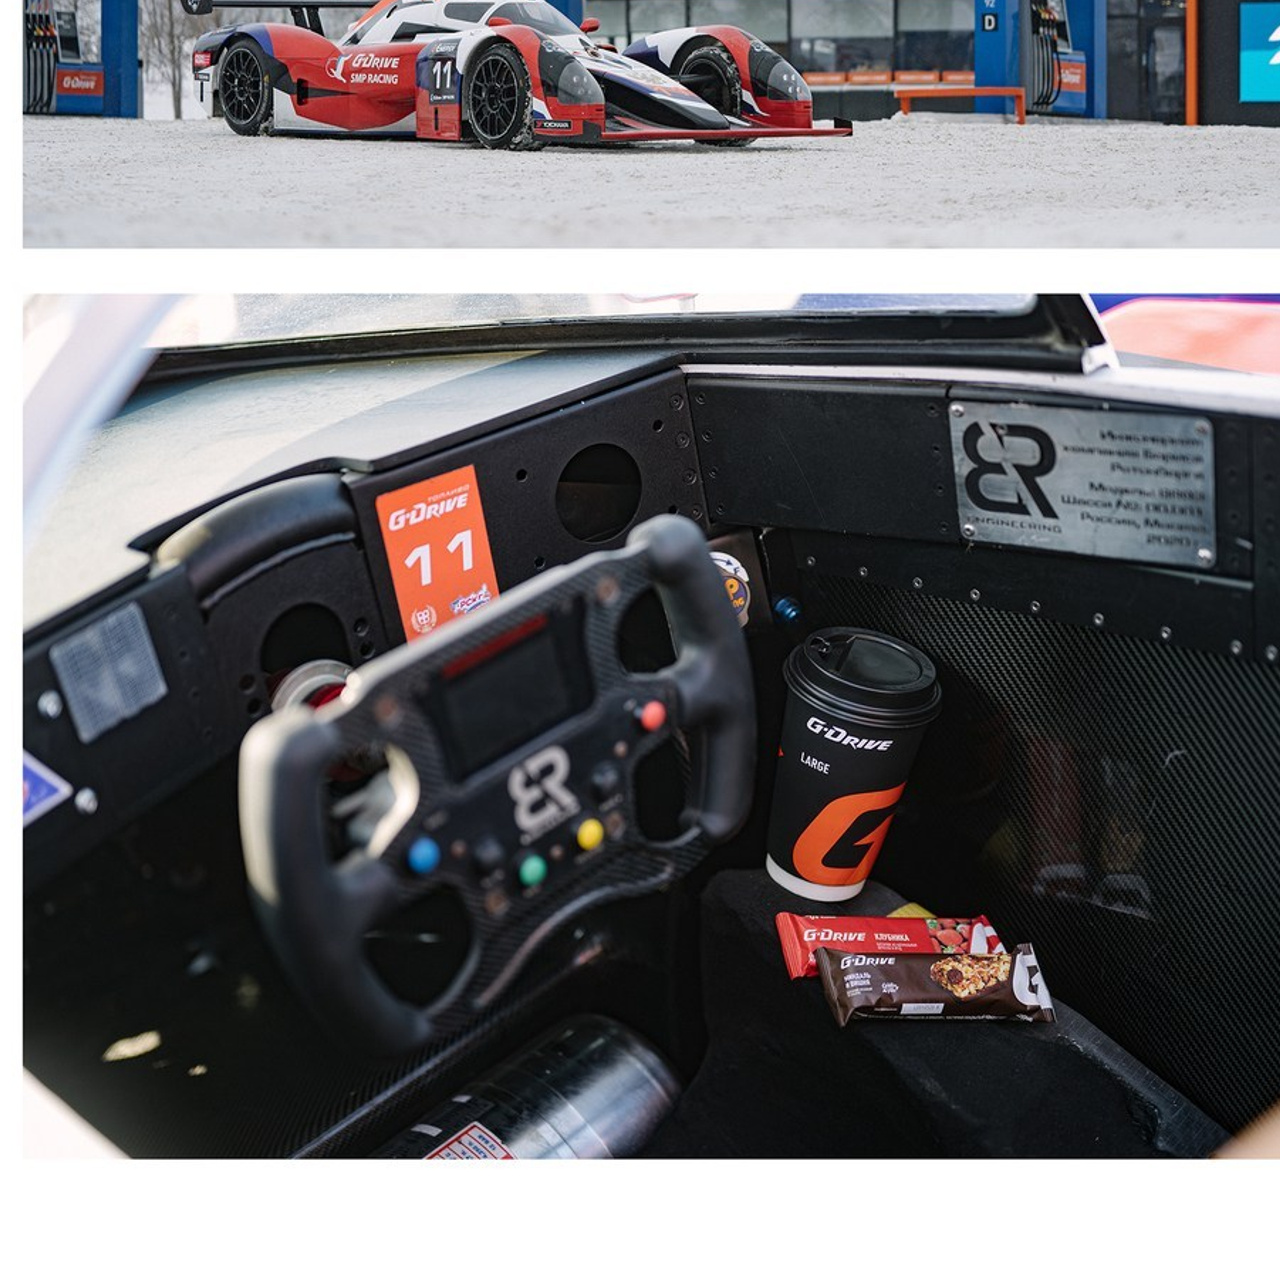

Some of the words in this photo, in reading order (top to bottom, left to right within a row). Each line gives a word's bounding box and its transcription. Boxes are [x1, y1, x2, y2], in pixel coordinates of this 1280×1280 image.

[984, 14, 996, 31] D
[351, 53, 400, 70] G-DRIVE
[350, 72, 367, 84] SMP
[367, 73, 399, 86] RACING
[432, 60, 452, 90] 11
[427, 484, 470, 502] ТОПЛИВО
[387, 493, 469, 531] G-DRIVE
[966, 515, 1063, 535] ENGINEERING
[805, 716, 894, 752] G-DRIVE
[800, 751, 831, 776] LARGE
[803, 928, 867, 943] G-DRIVE
[840, 954, 896, 970] G-DRIVE
